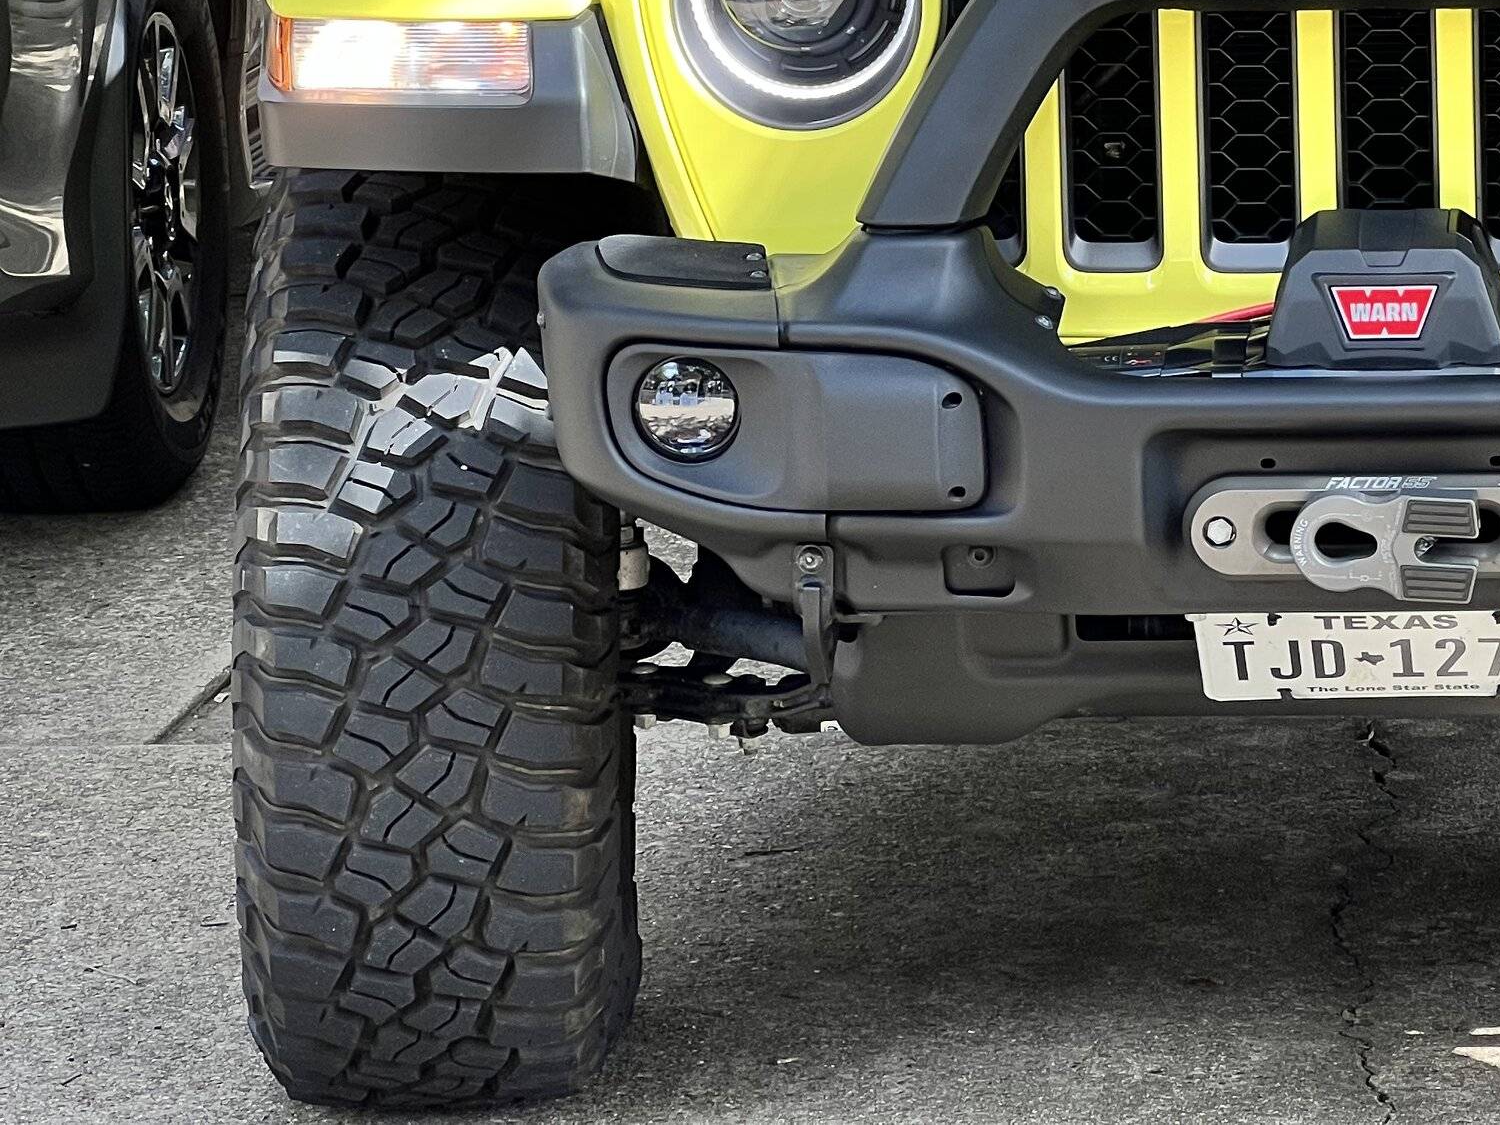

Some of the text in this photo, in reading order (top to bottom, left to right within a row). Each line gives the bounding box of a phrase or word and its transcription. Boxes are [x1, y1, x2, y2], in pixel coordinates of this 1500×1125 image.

[1349, 301, 1418, 322] WARN
[1325, 476, 1403, 490] FACTOR
[1293, 518, 1309, 567] WARNING
[1313, 614, 1459, 631] TEXAS
[1222, 638, 1346, 681] TJD
[1434, 683, 1480, 691] State
